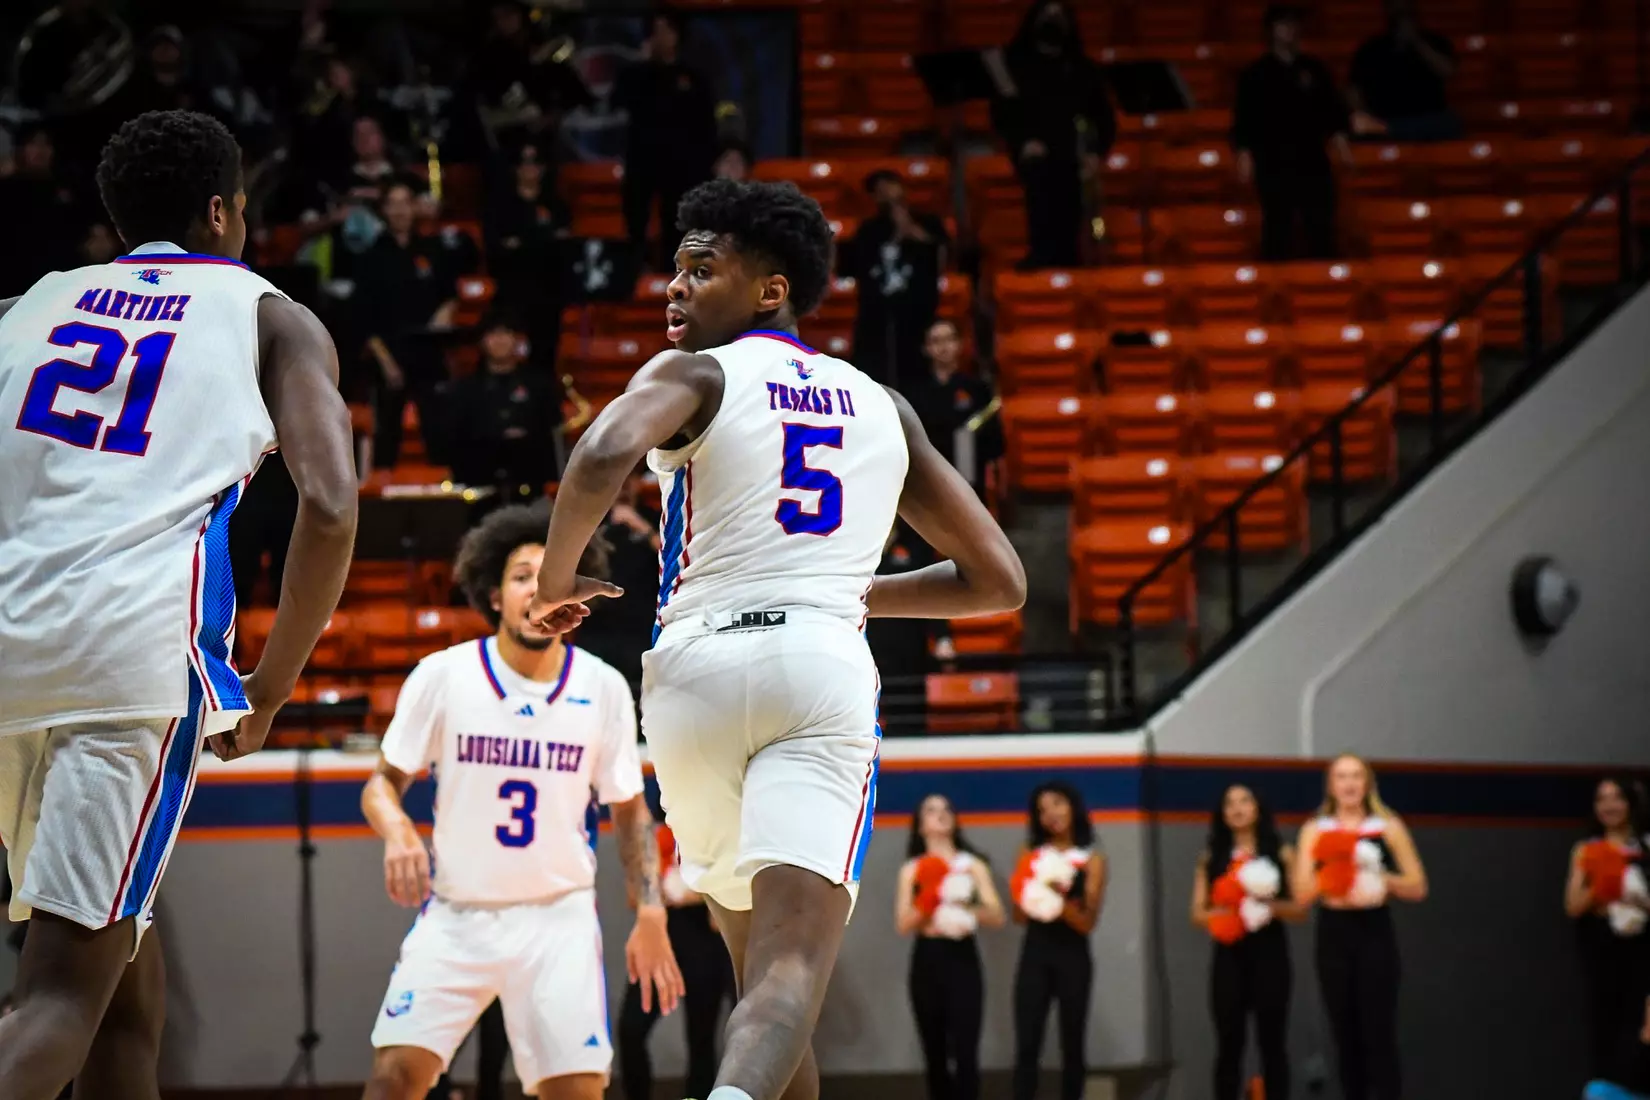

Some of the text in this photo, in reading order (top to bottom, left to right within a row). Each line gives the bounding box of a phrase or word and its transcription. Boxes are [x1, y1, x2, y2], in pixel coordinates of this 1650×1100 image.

[74, 288, 191, 322] MARTINEZ
[15, 321, 177, 457] 21
[774, 421, 844, 537] 5
[457, 734, 541, 769] LOUISIANA
[495, 780, 538, 848] 3
